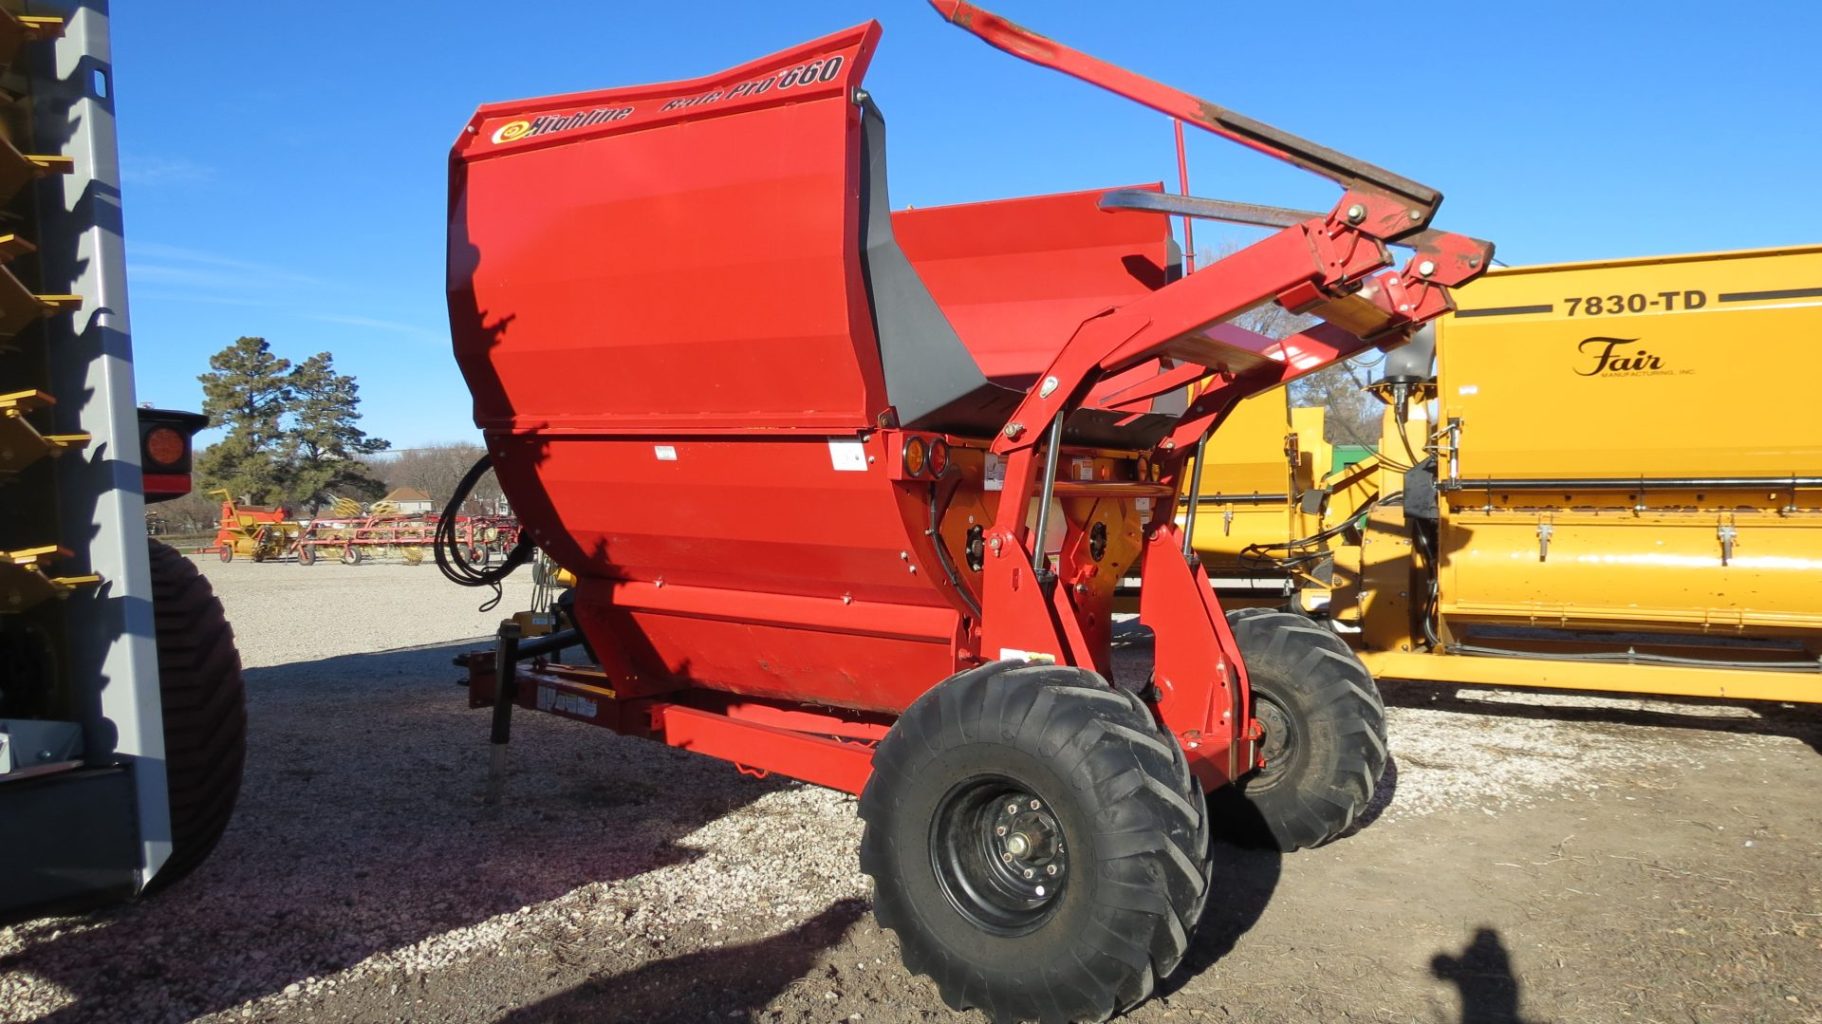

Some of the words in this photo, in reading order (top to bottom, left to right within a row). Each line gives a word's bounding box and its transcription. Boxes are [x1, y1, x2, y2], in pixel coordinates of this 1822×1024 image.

[525, 107, 634, 138] Highline
[725, 77, 777, 100] Pro
[777, 55, 844, 90] 660
[1564, 290, 1707, 317] 7830-TD
[1572, 336, 1665, 376] Fair
